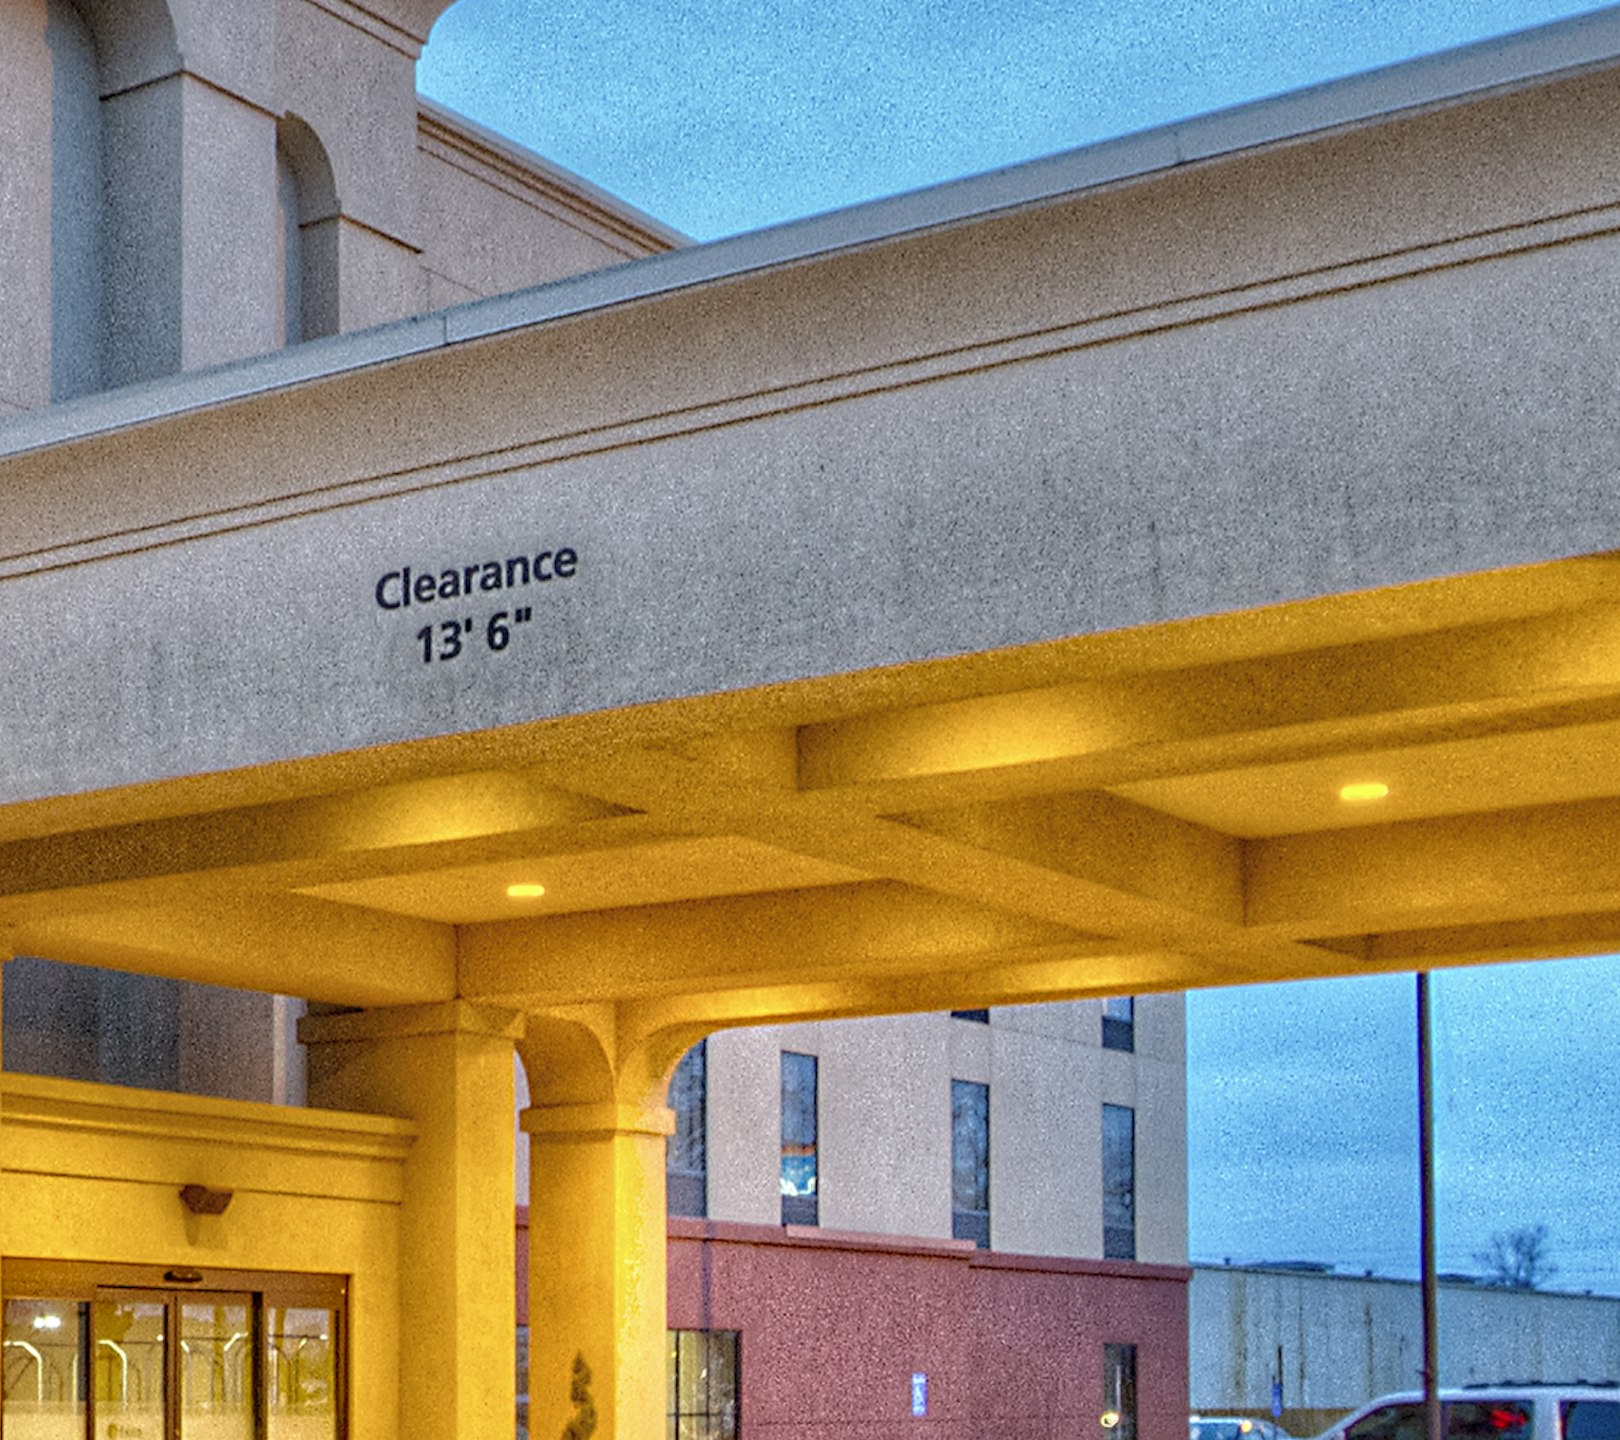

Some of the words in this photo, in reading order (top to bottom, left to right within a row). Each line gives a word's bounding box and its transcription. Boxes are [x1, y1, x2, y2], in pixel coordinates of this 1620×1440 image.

[374, 546, 579, 610] Clearance
[416, 616, 473, 663] 13'
[486, 606, 532, 652] 6"
